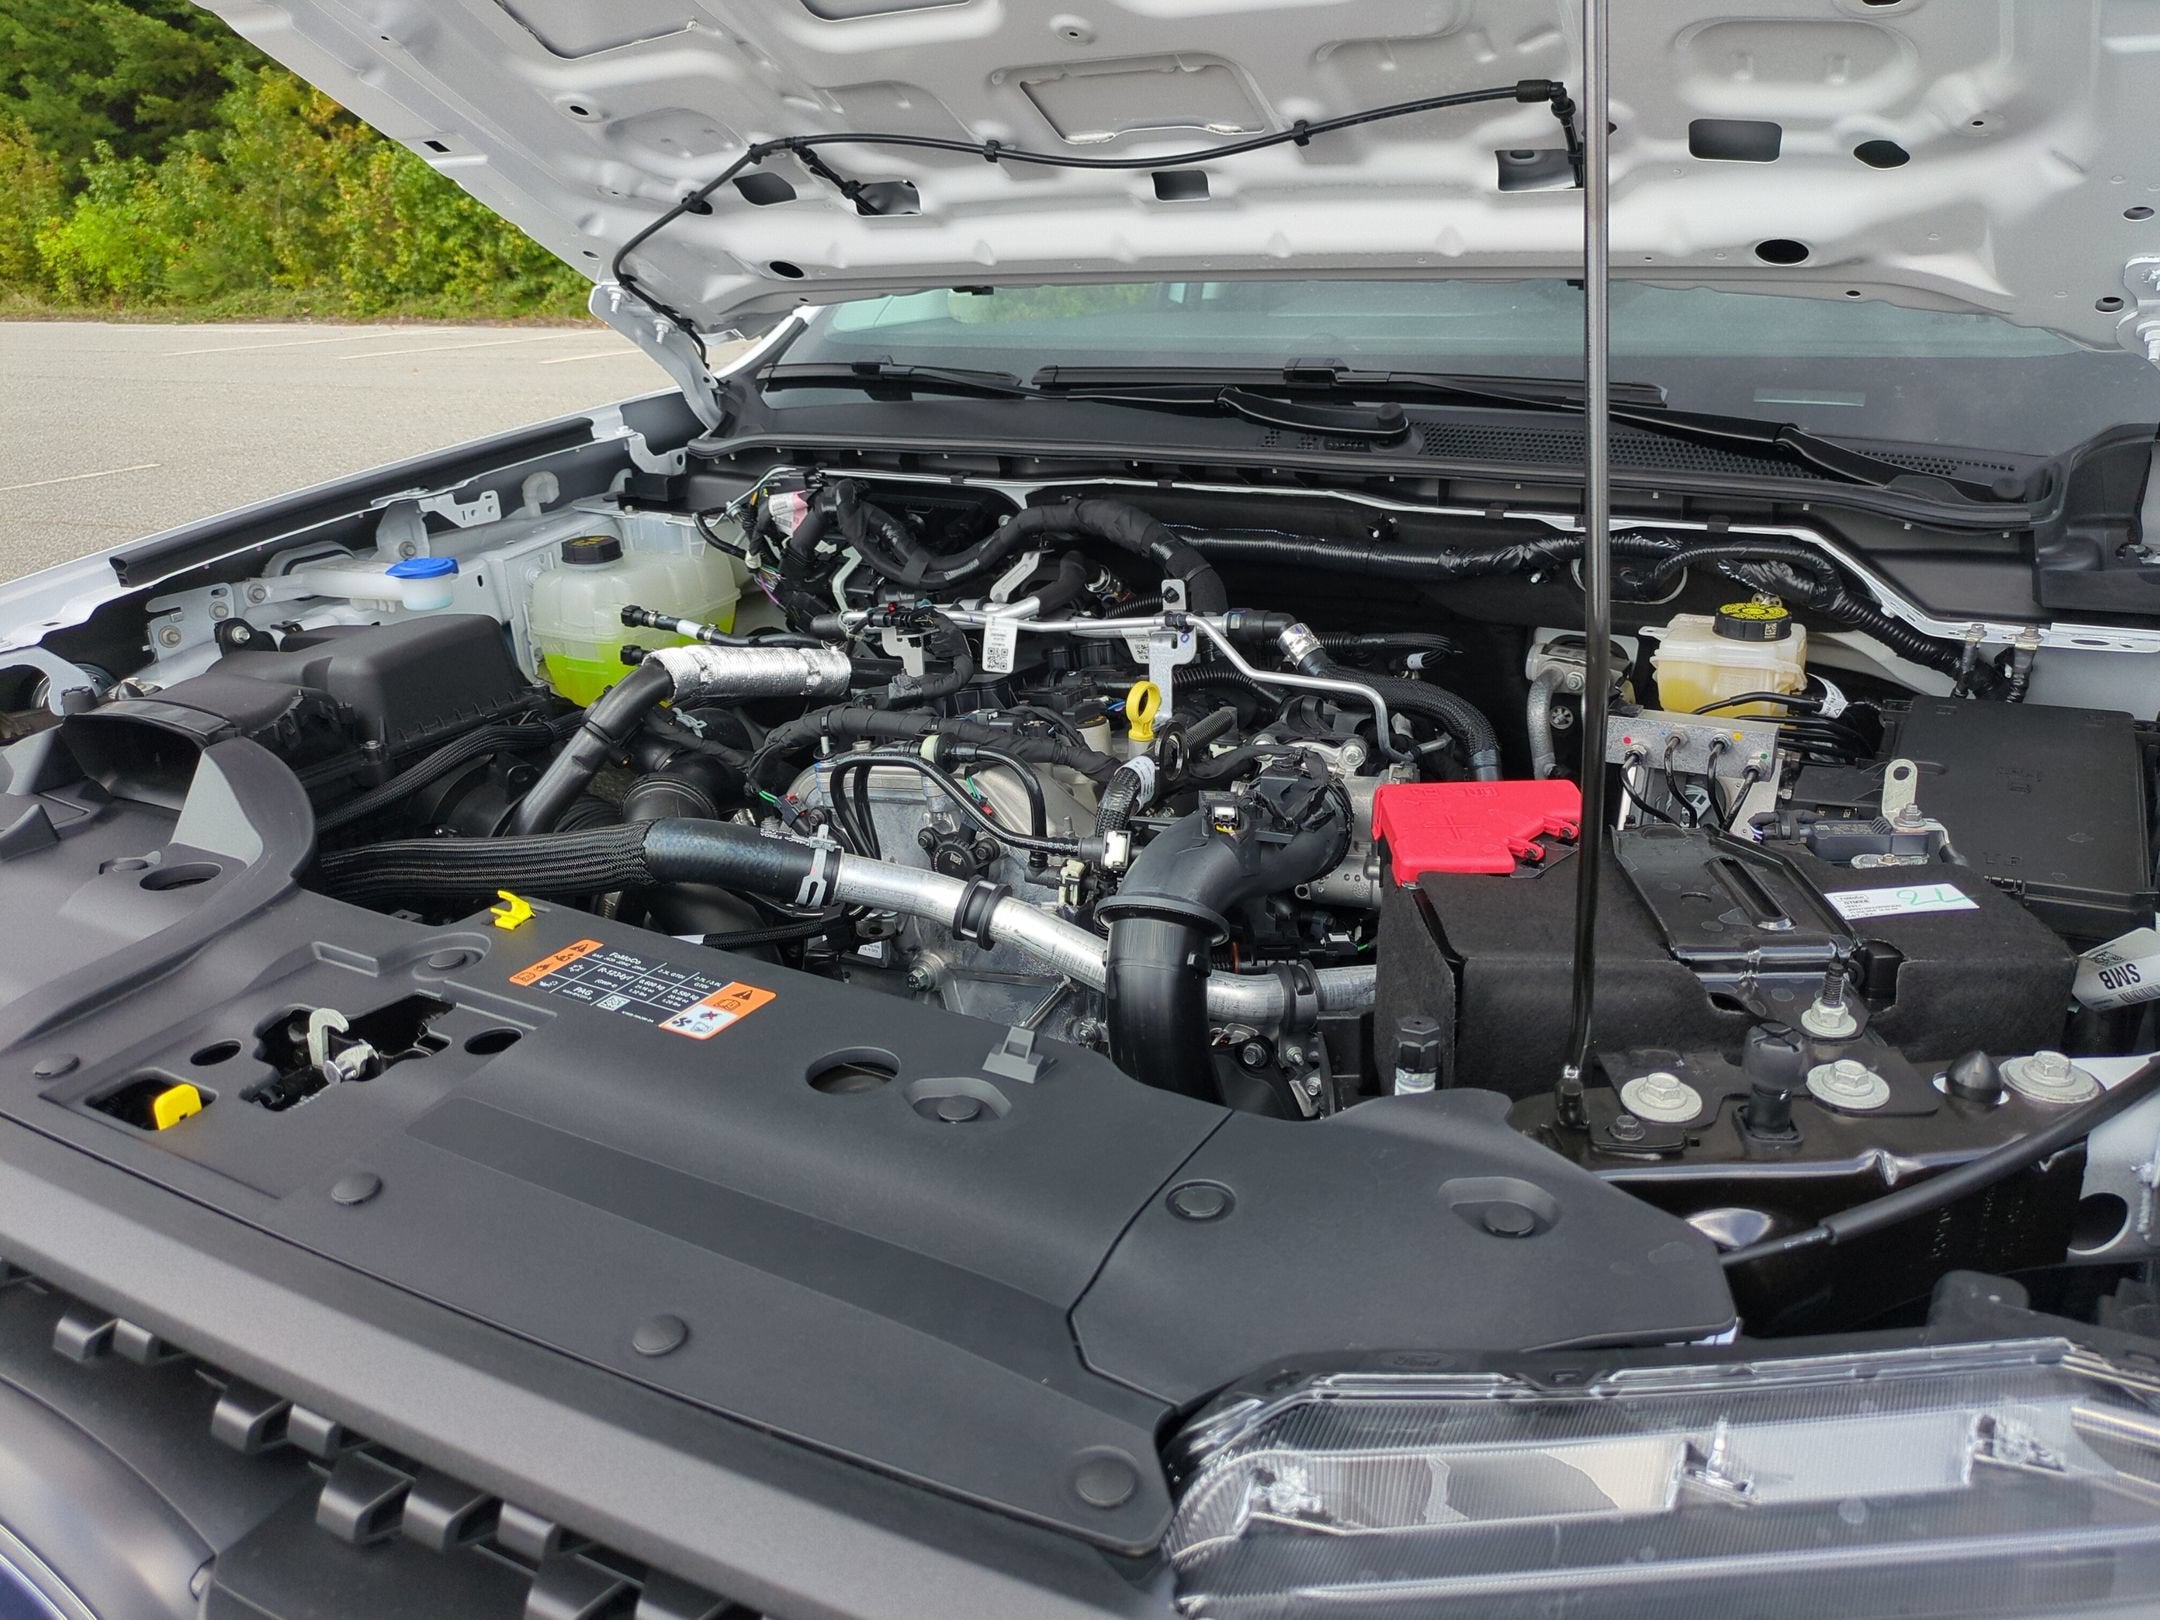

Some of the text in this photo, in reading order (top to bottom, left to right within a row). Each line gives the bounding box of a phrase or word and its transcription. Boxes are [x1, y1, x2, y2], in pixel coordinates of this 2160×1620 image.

[609, 952, 641, 965] FoMoCo
[597, 967, 634, 980] R-1234yf
[2099, 963, 2141, 990] SMB
[573, 986, 594, 995] PAG
